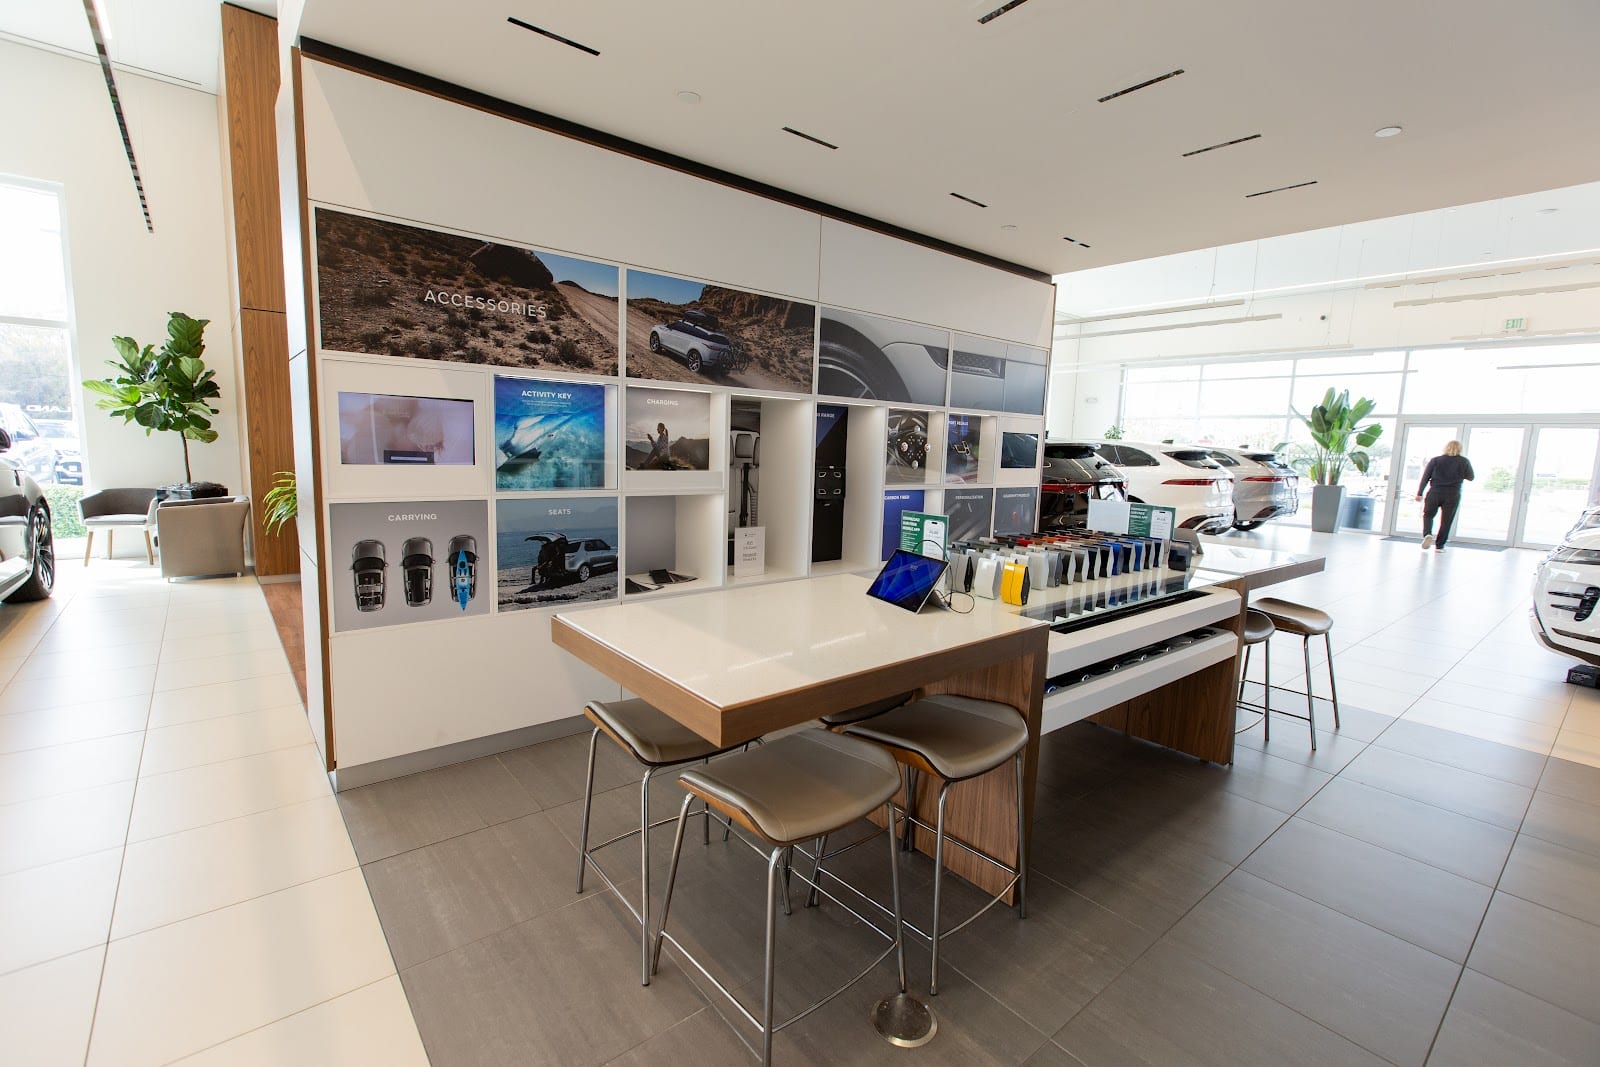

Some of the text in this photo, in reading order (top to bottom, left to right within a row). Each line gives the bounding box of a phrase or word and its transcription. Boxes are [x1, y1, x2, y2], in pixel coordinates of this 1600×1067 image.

[423, 289, 547, 318] ACCESSORIES
[1505, 318, 1524, 329] EXIT
[521, 390, 572, 400] ACTIVITY KEY
[646, 398, 679, 406] CHARGING
[548, 508, 572, 516] SEATS
[387, 513, 438, 522] CARRYING
